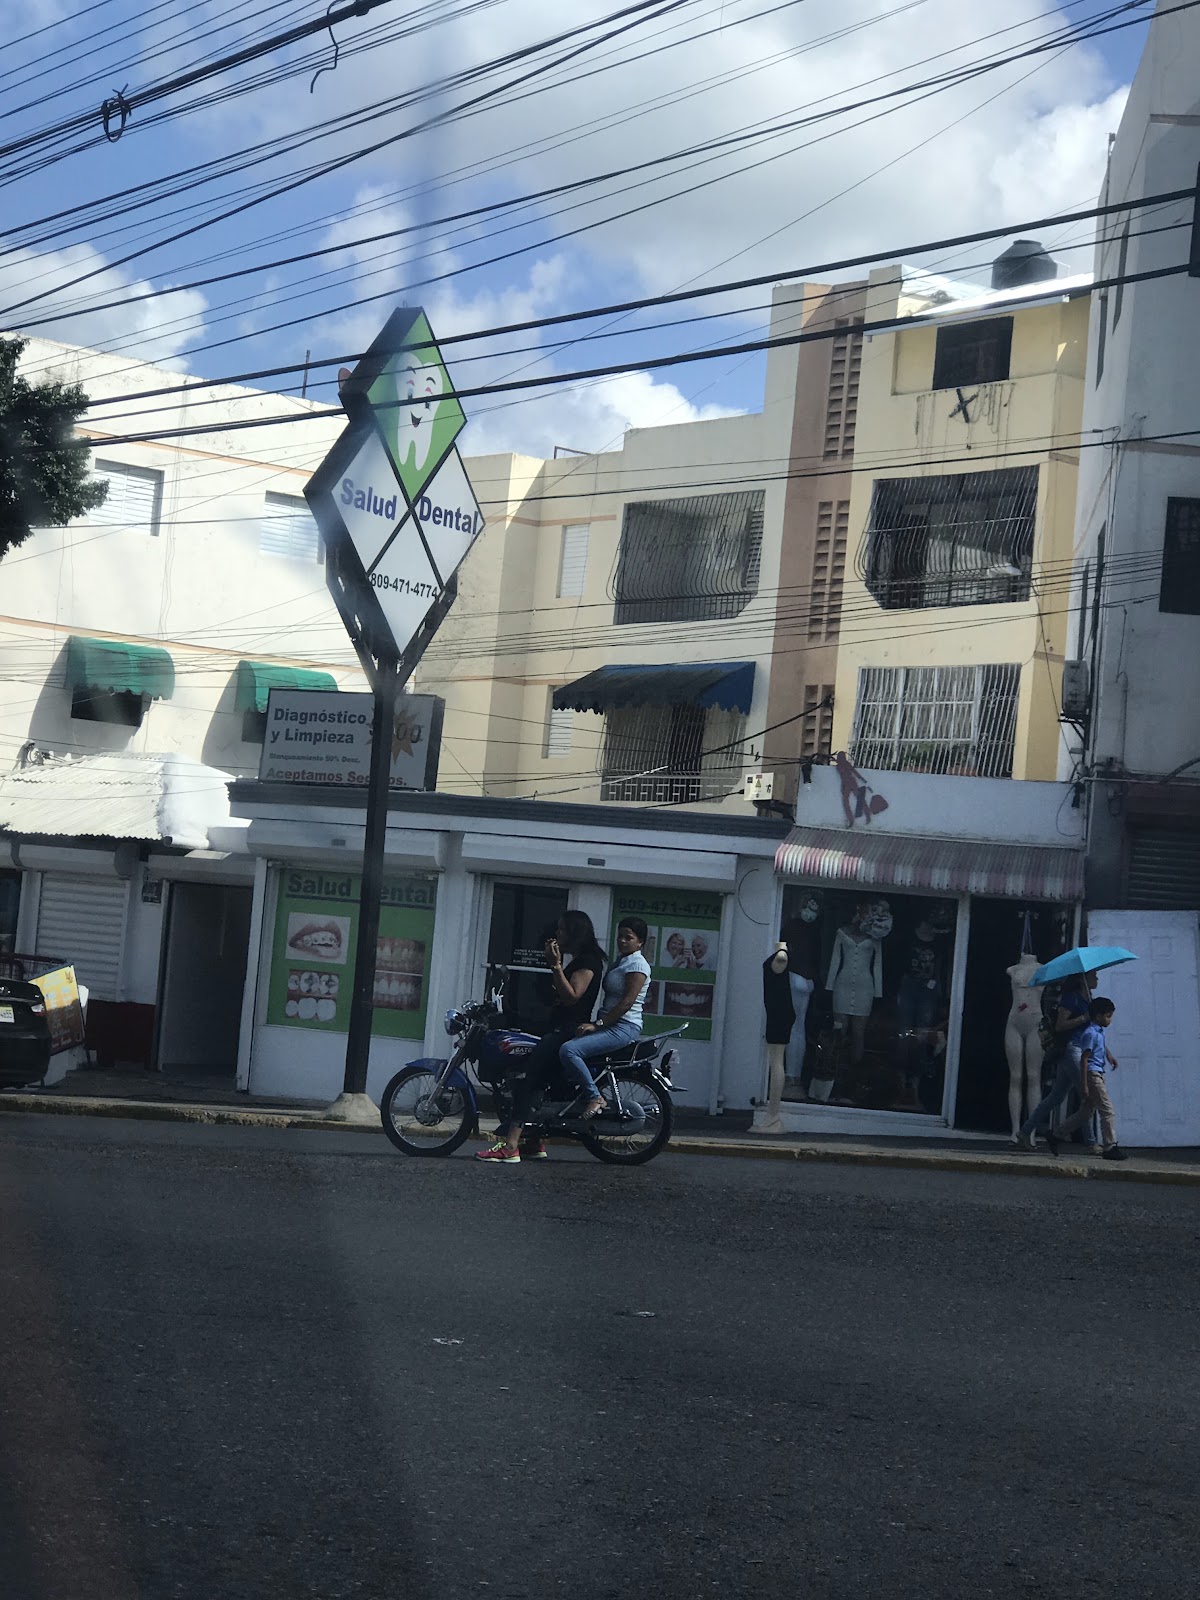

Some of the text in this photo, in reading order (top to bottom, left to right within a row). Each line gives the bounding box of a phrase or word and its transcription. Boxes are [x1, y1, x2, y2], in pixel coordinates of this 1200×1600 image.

[340, 478, 478, 535] Salud Dental
[370, 572, 438, 600] 809-471-4774
[273, 708, 367, 725] Diagnóstico
[270, 728, 354, 746] y Limpieza
[266, 767, 407, 786] Aceptamos Seos.
[287, 873, 435, 904] Salud ental
